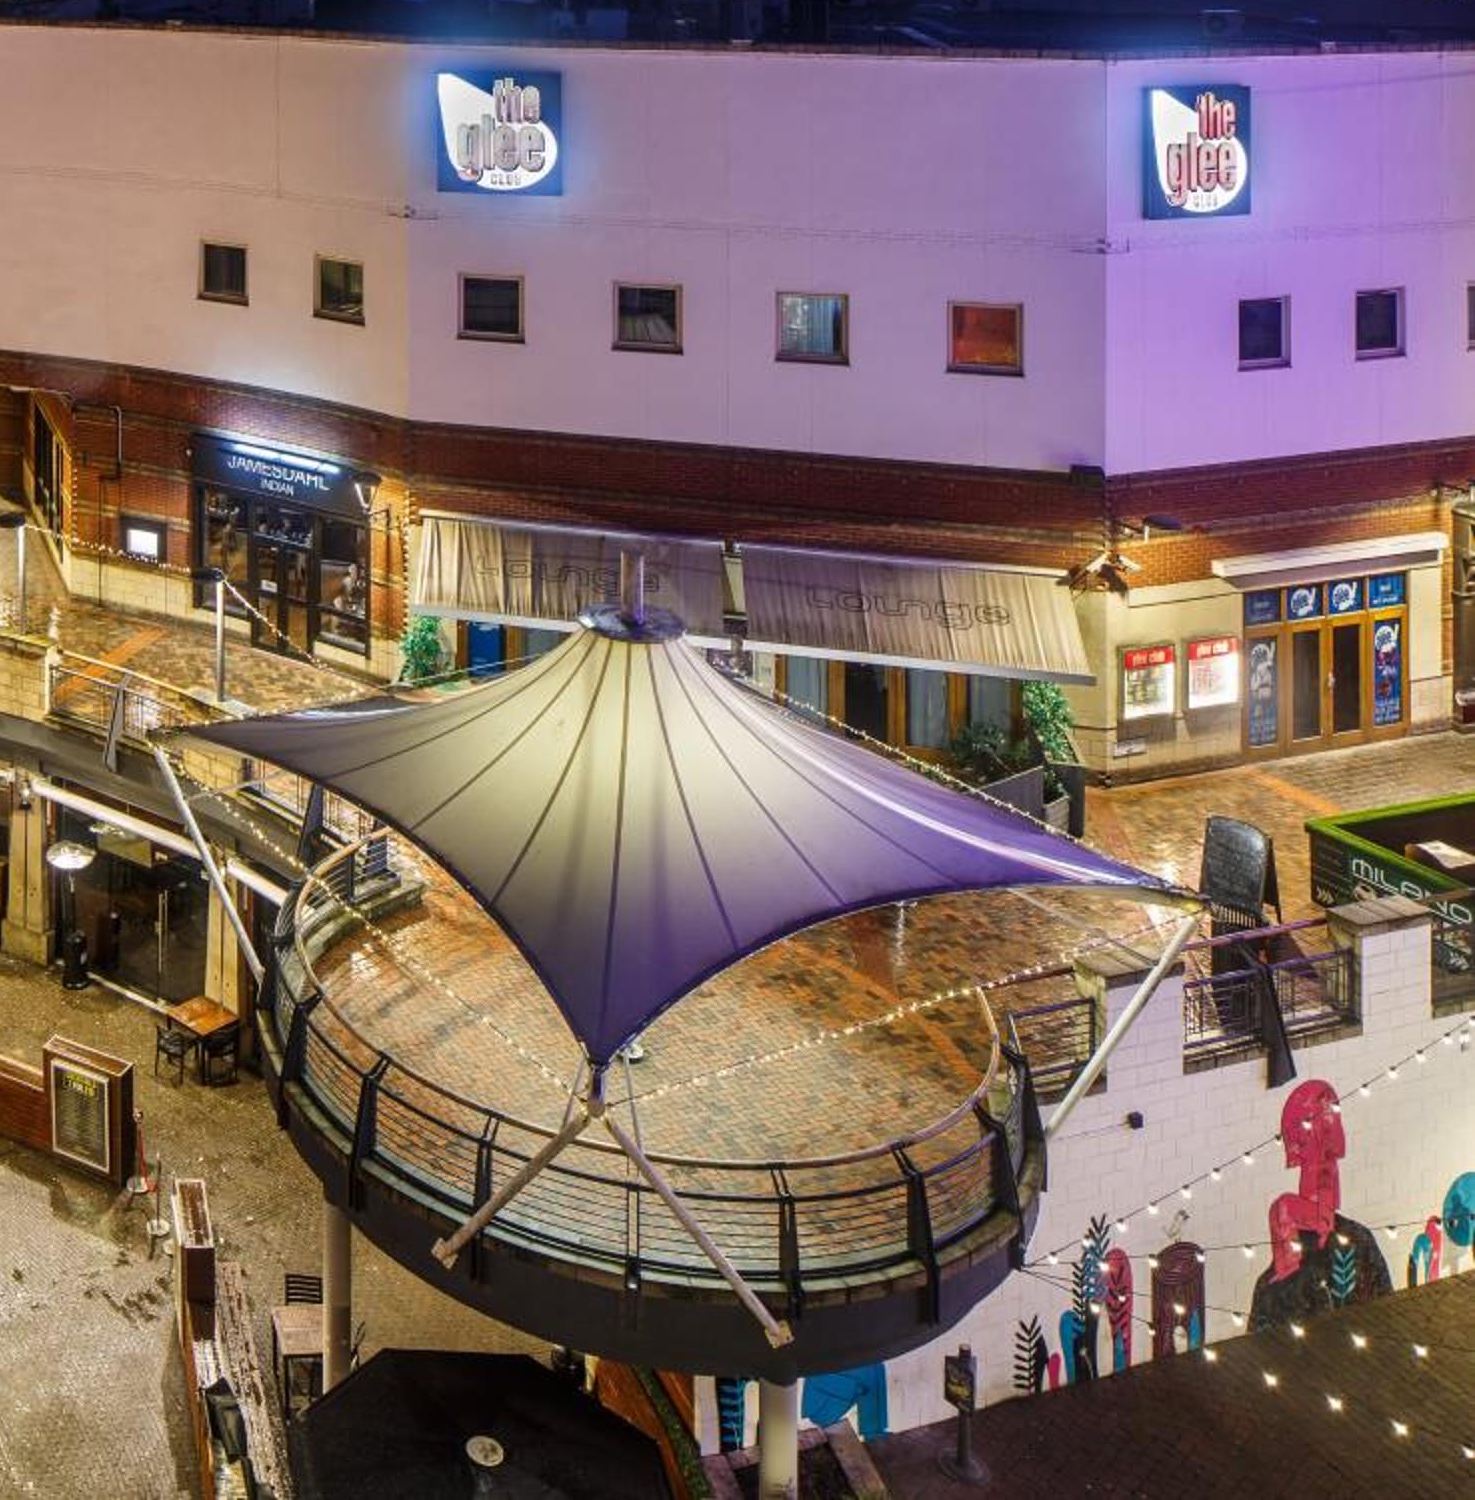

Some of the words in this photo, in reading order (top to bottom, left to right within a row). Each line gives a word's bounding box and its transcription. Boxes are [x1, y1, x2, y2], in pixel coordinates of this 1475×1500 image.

[1196, 91, 1237, 140] the
[456, 113, 546, 182] glee
[1166, 131, 1238, 207] glee
[260, 479, 294, 497] INDIAN
